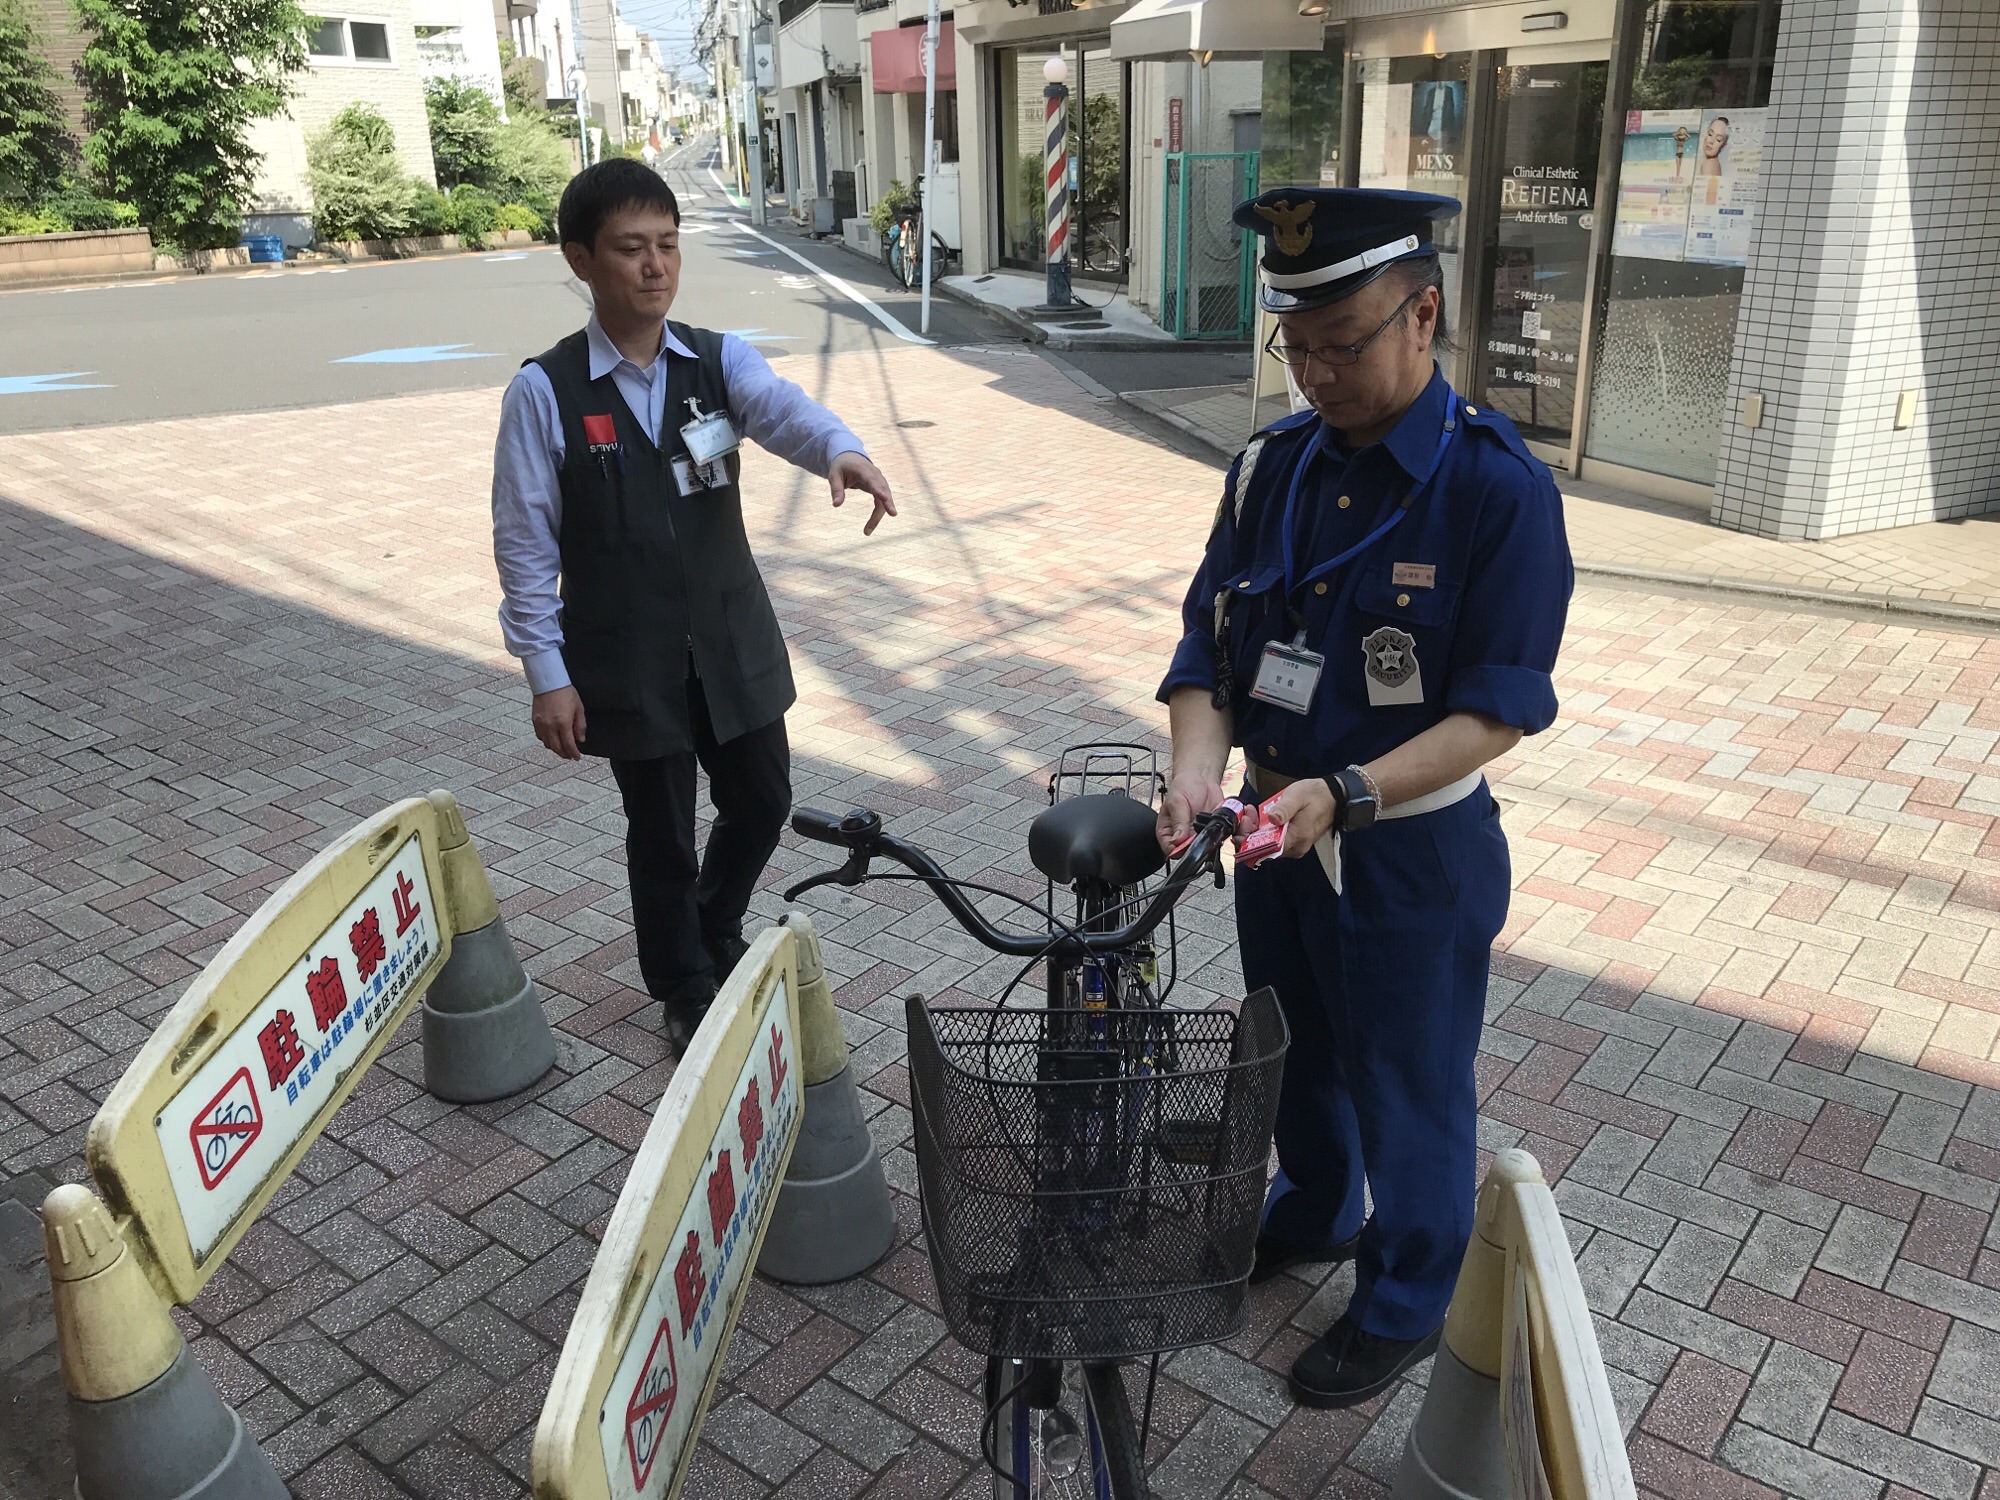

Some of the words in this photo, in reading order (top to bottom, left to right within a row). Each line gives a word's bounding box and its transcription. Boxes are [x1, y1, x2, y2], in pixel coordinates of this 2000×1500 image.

[1416, 154, 1454, 170] MEN'S
[1513, 166, 1544, 179] Clinical
[1545, 167, 1579, 180] Esthetic
[1502, 179, 1588, 207] REFIENA
[1515, 211, 1532, 222] And
[1534, 212, 1547, 222] for
[1548, 212, 1568, 225] Men
[1495, 367, 1507, 378] TEL
[1370, 634, 1409, 652] ZENKEI
[1371, 662, 1412, 680] SECURITY
[257, 870, 421, 1092] 駐輪禁止
[674, 1022, 788, 1341] 駐輪禁止
